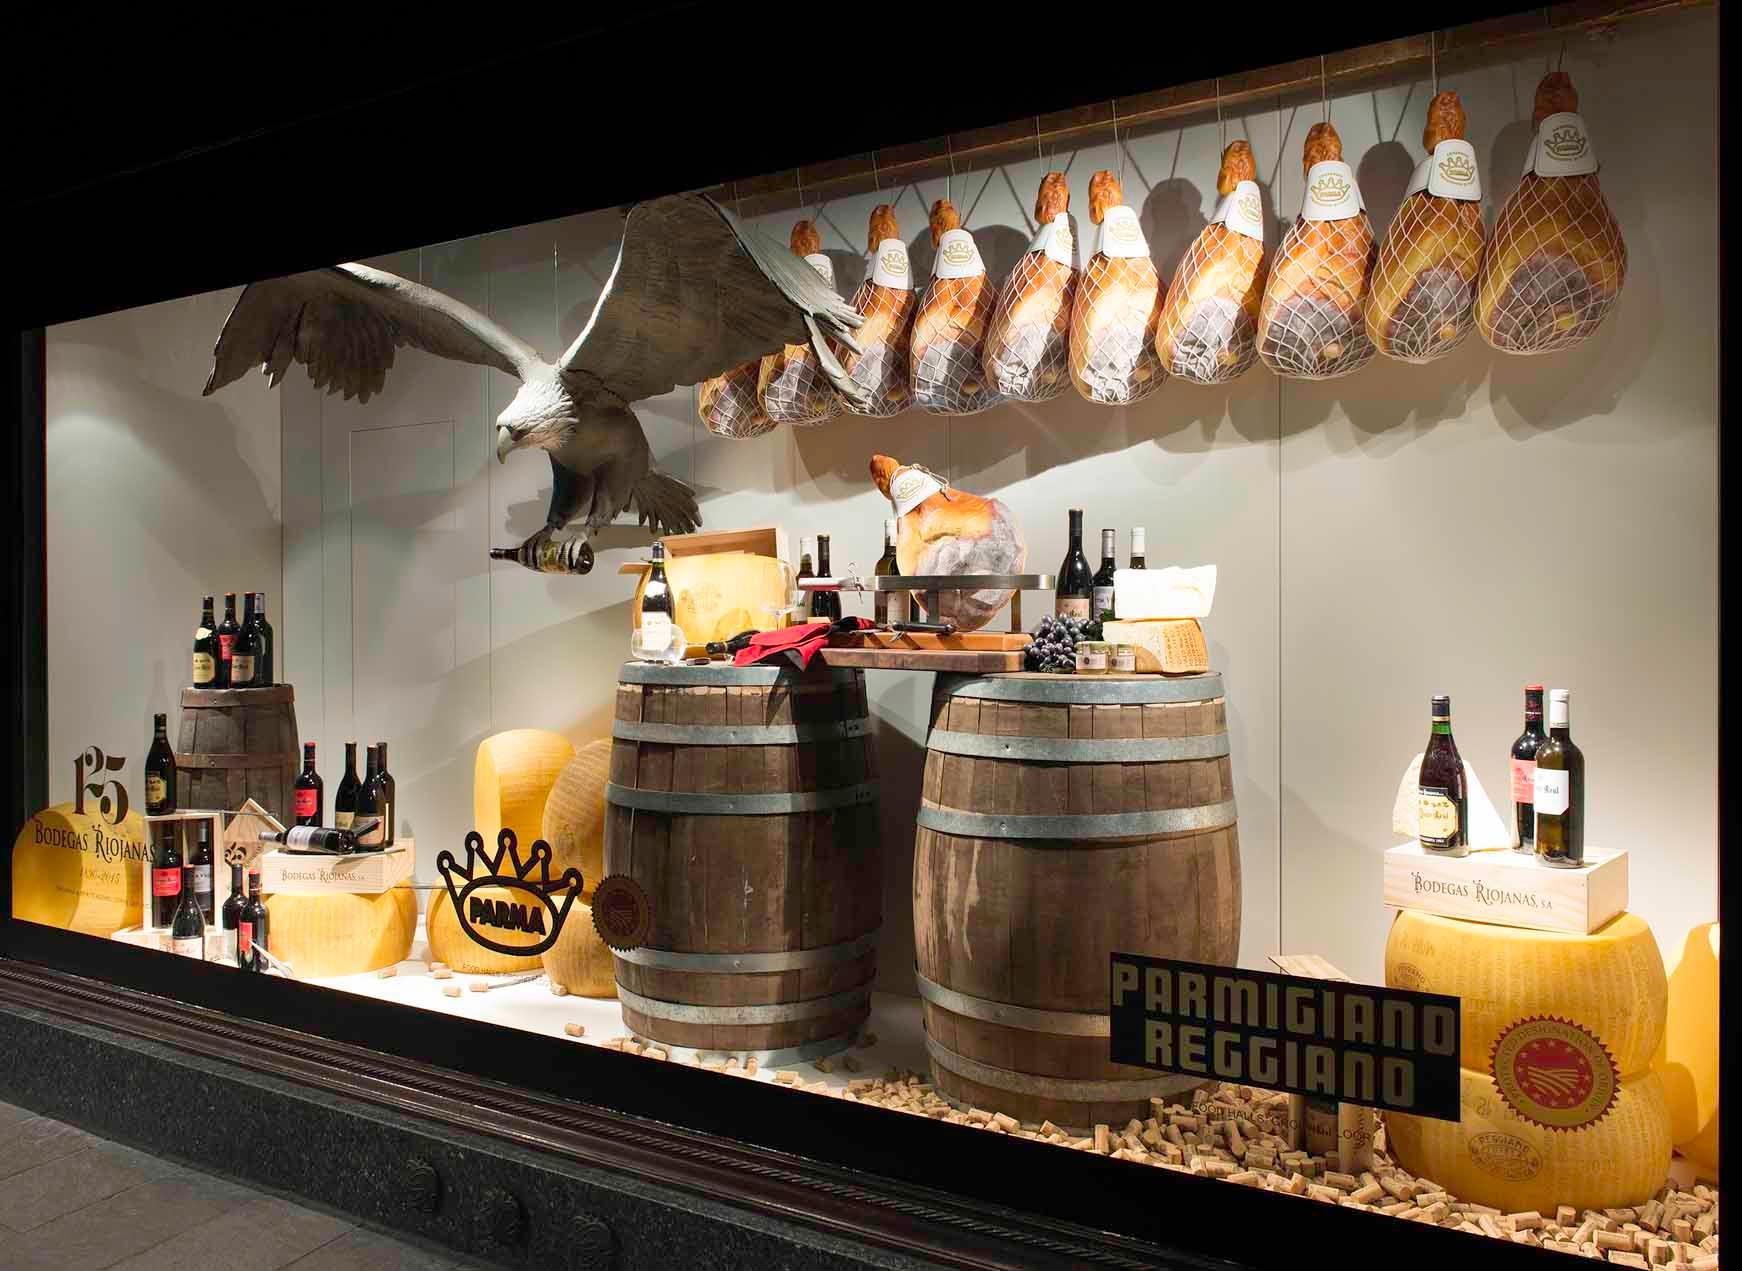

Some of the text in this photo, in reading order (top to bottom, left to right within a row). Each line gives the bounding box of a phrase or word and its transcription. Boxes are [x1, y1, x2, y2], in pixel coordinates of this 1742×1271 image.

[33, 817, 156, 863] BODEGAS RIOJANAS
[280, 868, 316, 881] BODEGAS
[1411, 871, 1469, 897] BODEGAS
[470, 896, 546, 936] PARMA
[1112, 961, 1455, 1057] PARMIGIANO
[1145, 1018, 1415, 1107] REGGIANO
